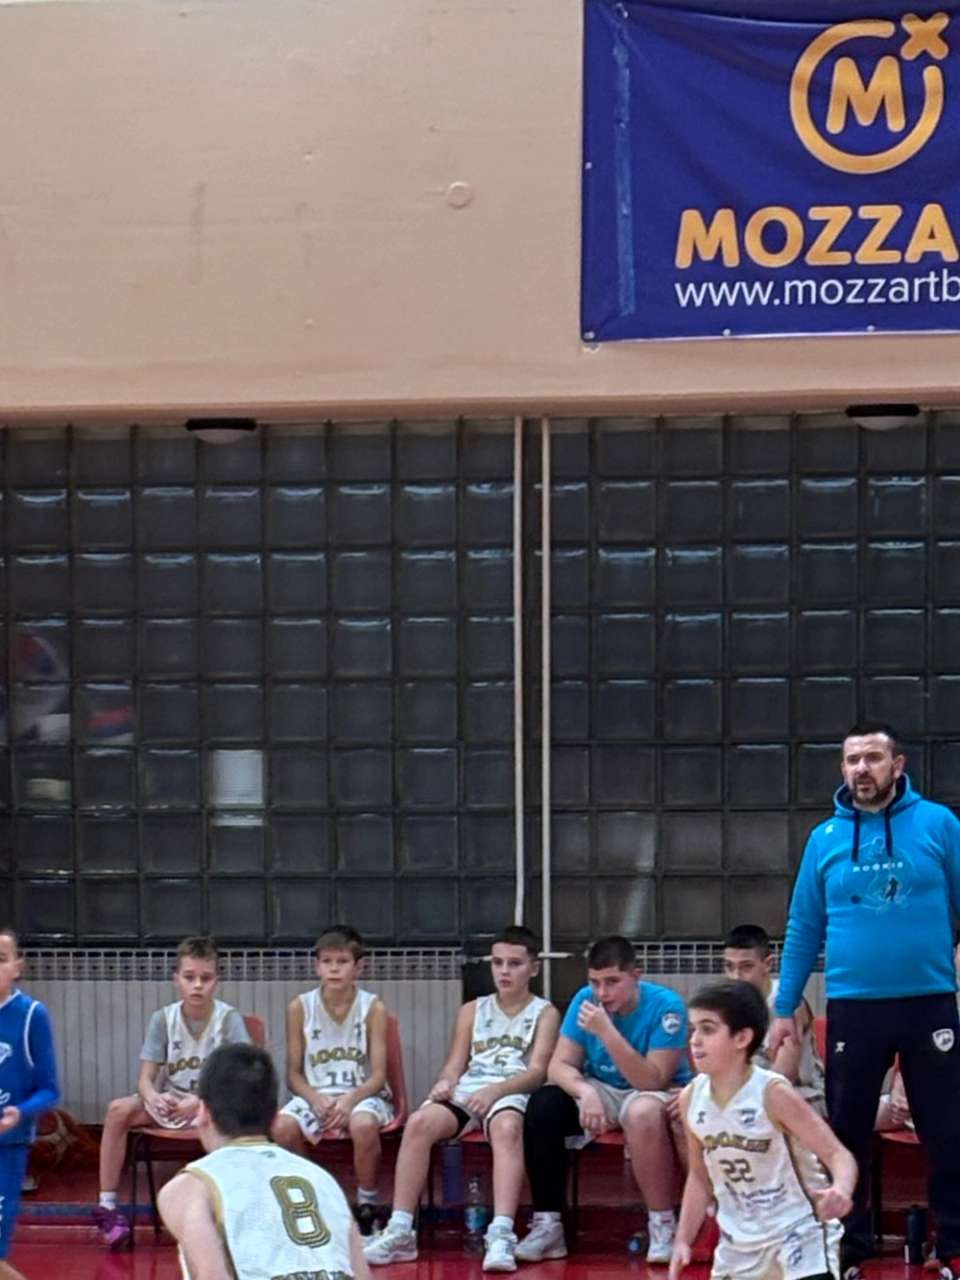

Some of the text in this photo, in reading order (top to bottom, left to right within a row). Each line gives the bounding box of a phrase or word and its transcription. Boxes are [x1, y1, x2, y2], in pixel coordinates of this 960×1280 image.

[674, 203, 960, 269] MOZZA
[674, 268, 960, 307] www.mozzartb
[718, 1158, 756, 1183] 22
[269, 1175, 332, 1249] 8
